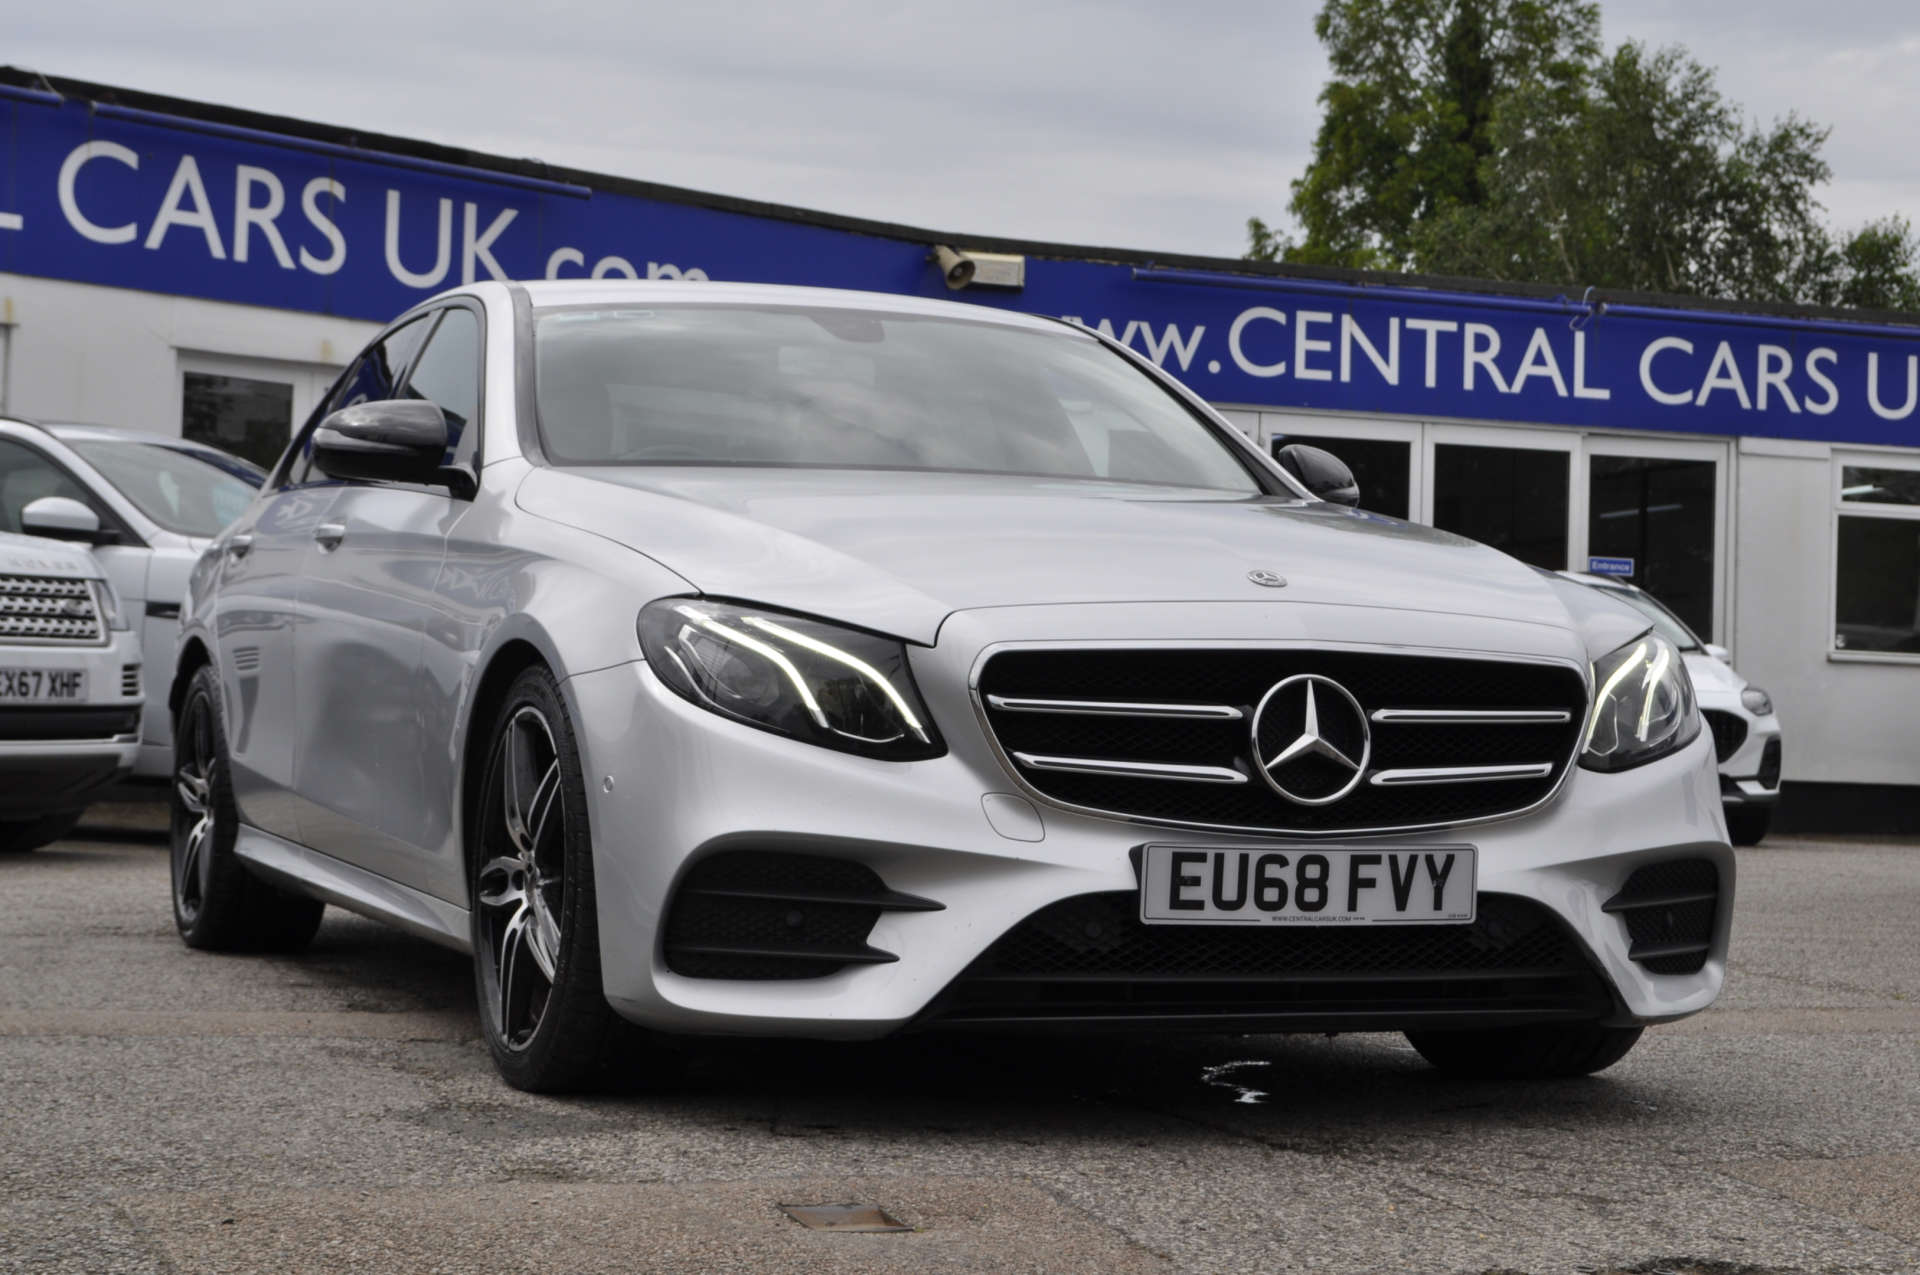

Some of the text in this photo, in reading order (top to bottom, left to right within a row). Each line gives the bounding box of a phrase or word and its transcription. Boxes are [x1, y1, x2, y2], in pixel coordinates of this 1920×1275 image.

[58, 140, 519, 289] CARS UK
[1638, 336, 1840, 416] CARS
[1592, 561, 1630, 571] Entrance
[0, 671, 82, 697] X67 XHF
[1168, 850, 1456, 913] EU68 FVY
